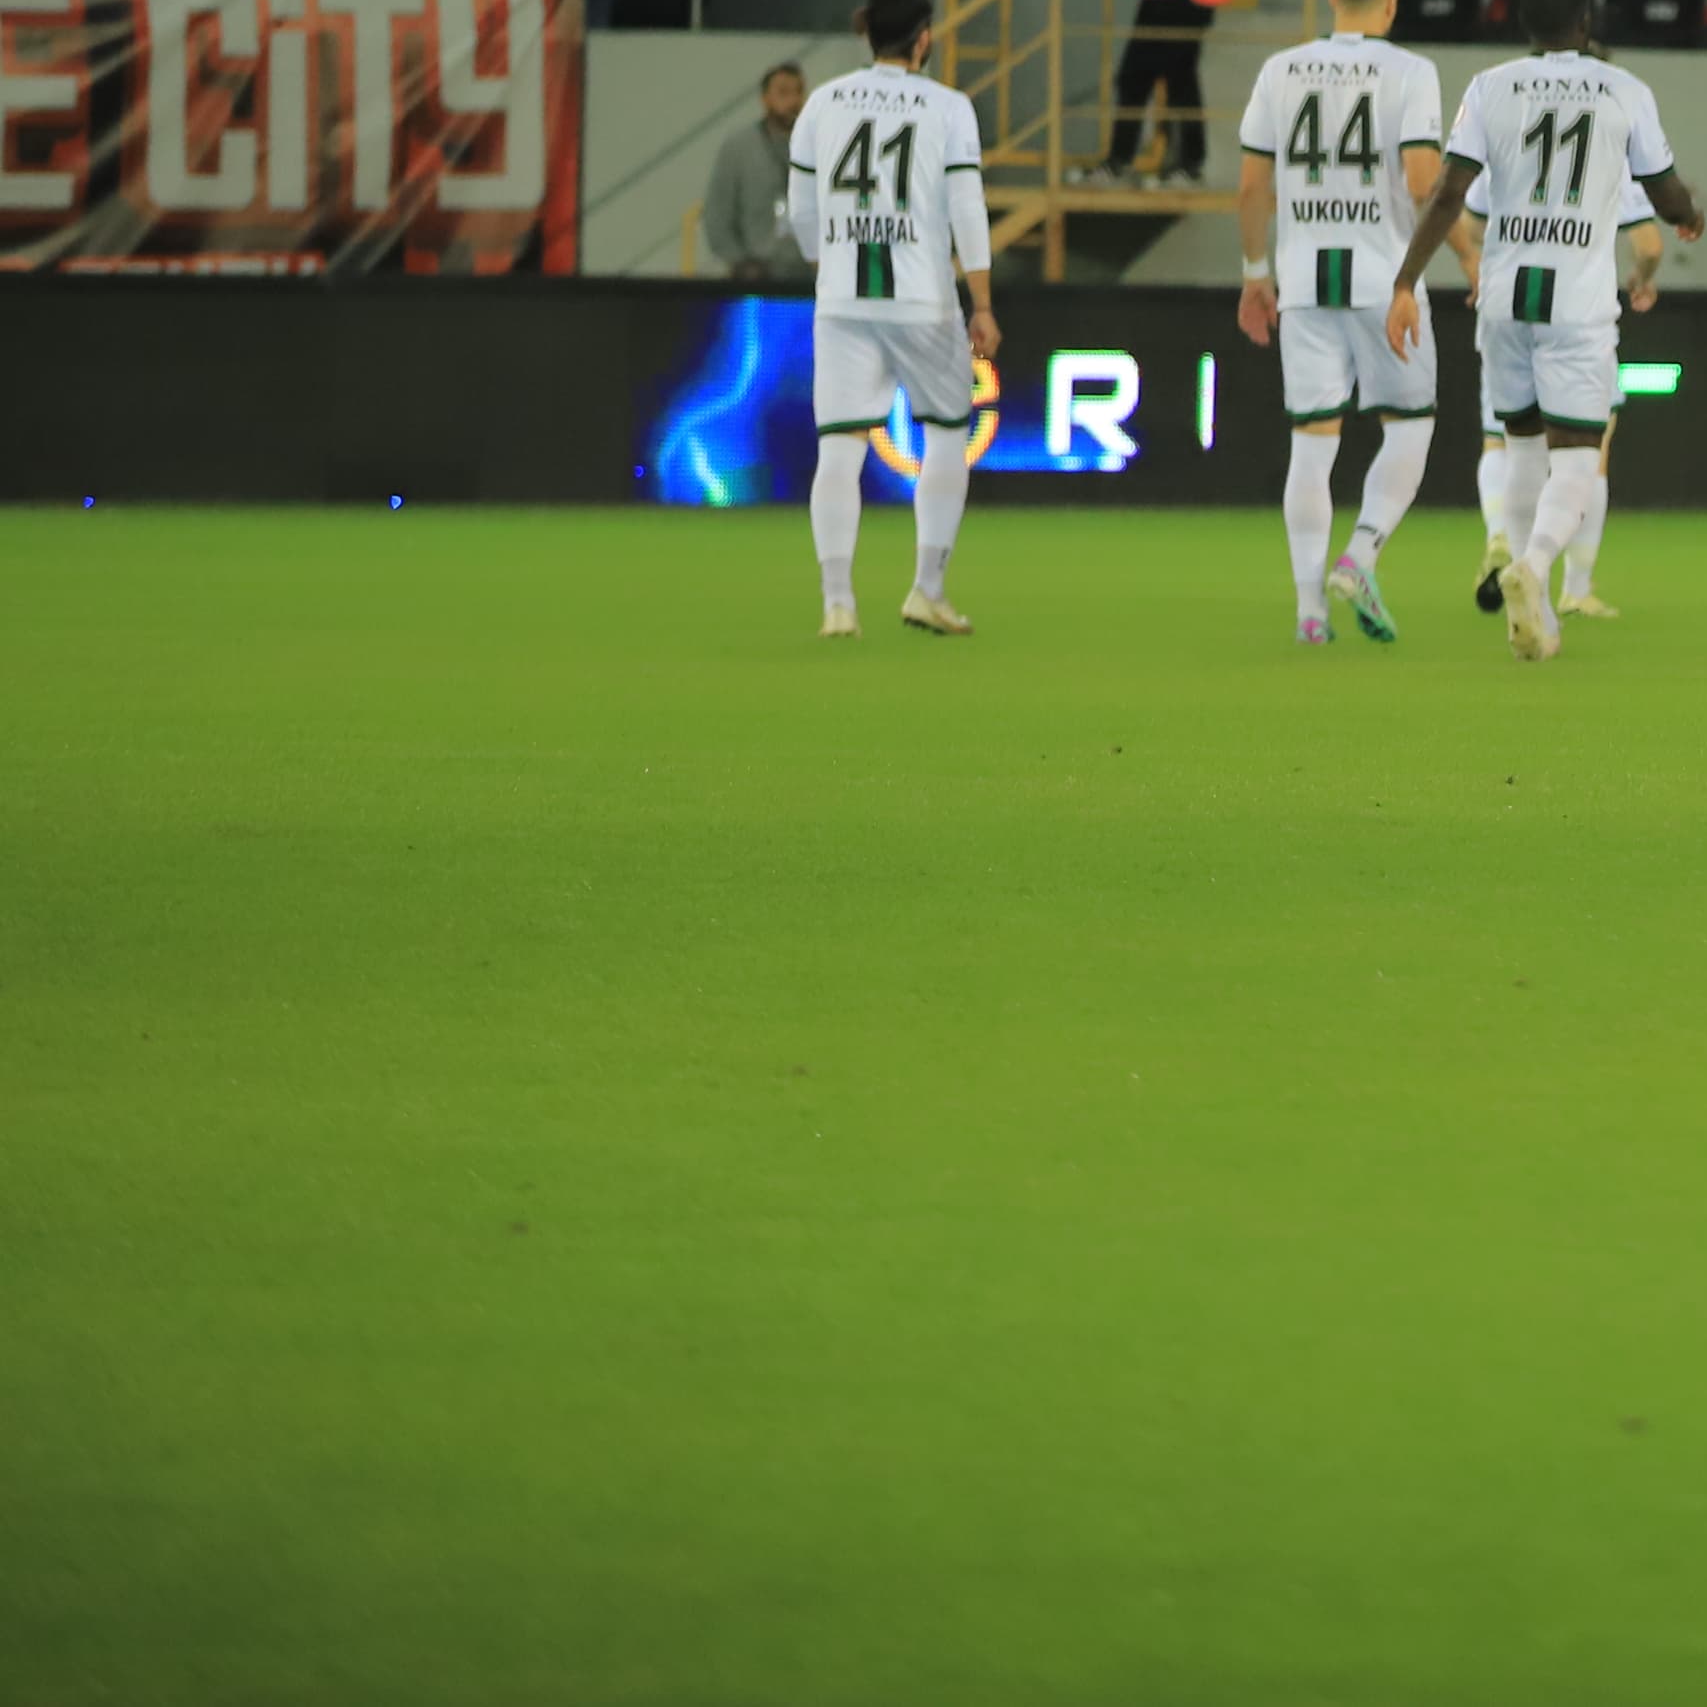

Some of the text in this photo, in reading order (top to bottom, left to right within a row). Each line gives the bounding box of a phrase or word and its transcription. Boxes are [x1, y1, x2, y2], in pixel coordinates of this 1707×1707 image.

[1288, 62, 1380, 77] KONAK
[833, 88, 927, 108] KONAK
[1513, 79, 1613, 96] KONAK
[1287, 90, 1383, 186] 44
[830, 119, 917, 213] 41
[1522, 109, 1595, 207] 11
[1499, 215, 1592, 248] KOUAKOU
